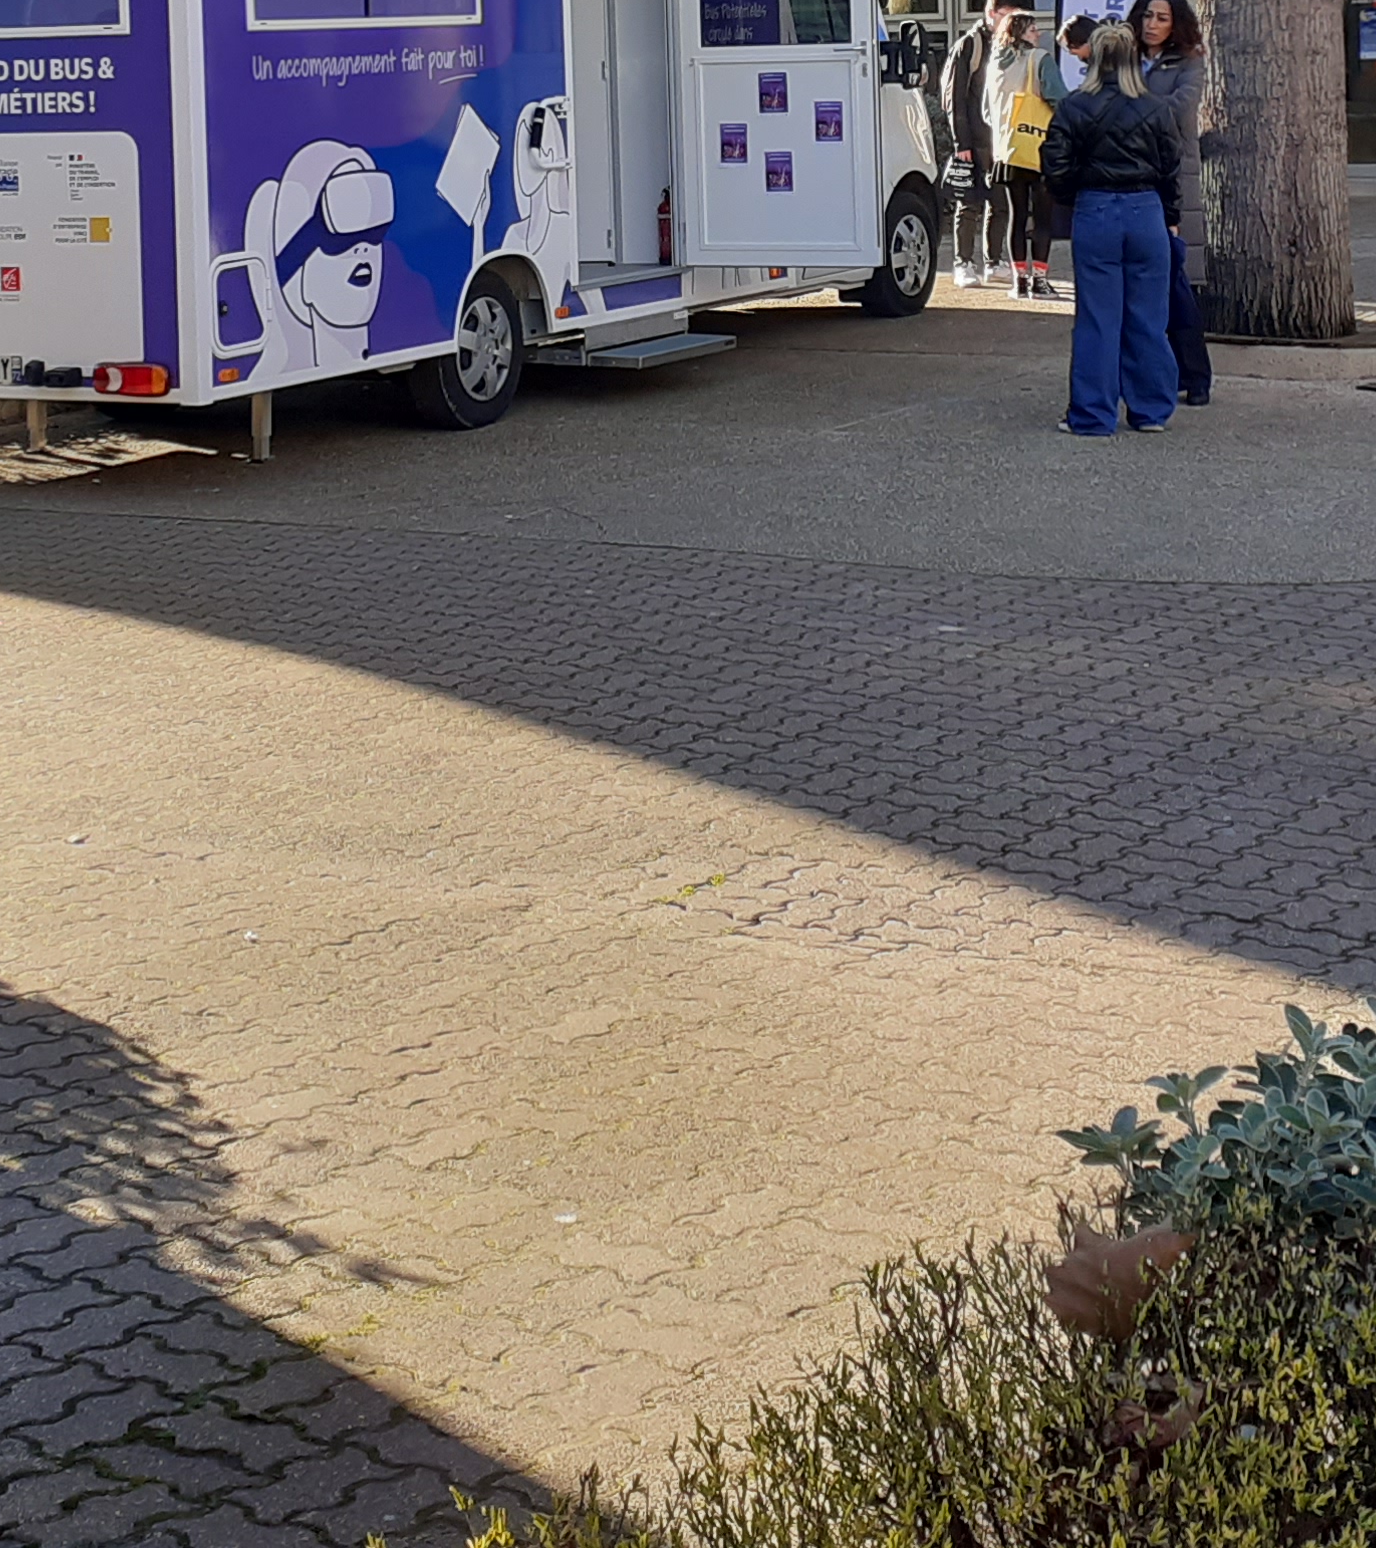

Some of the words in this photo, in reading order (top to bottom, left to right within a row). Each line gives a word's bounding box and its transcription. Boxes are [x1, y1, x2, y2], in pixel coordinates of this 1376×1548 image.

[13, 58, 45, 81] DU
[49, 57, 94, 80] BUS
[97, 56, 115, 80] &
[252, 55, 273, 81] Un
[277, 49, 396, 87] accompagnement
[401, 47, 424, 71] fait
[428, 51, 456, 80] pour
[459, 45, 478, 68] toi
[88, 90, 96, 113] !
